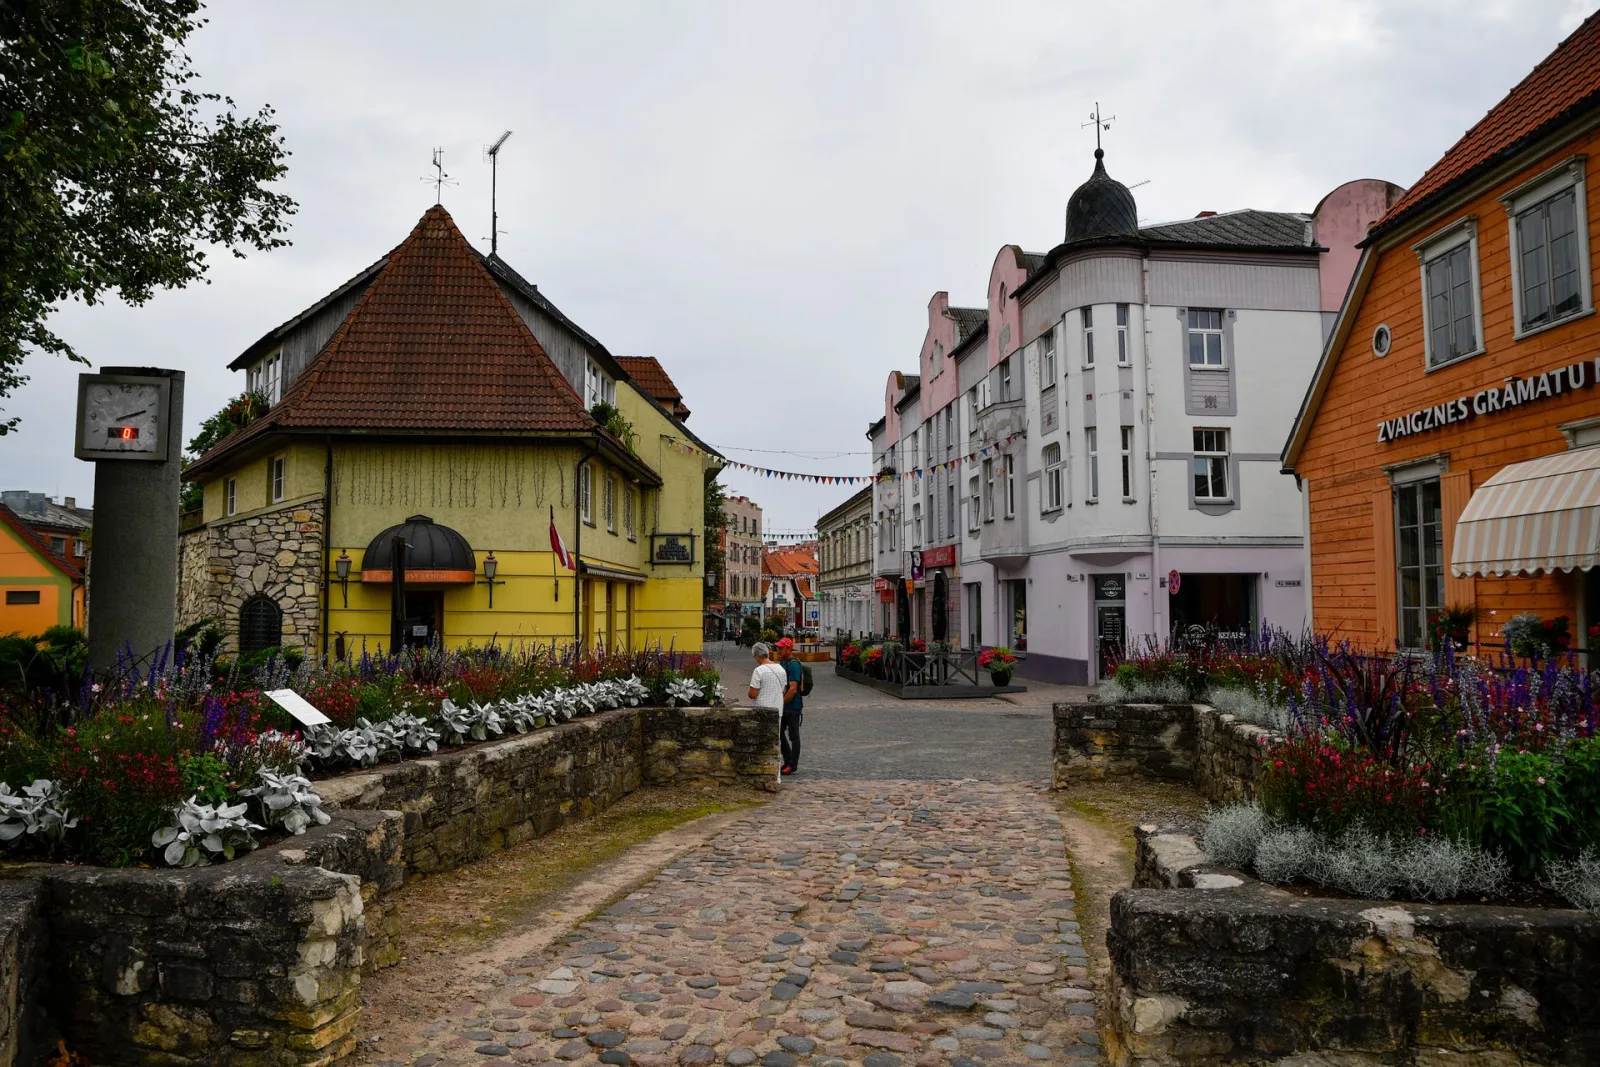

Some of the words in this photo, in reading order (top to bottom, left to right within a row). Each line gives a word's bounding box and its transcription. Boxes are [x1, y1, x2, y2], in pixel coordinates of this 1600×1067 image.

[120, 385, 132, 394] 12
[1377, 396, 1469, 443] ZVAIGZNES
[1473, 361, 1586, 415] GRĀMATU
[90, 413, 97, 421] 9
[151, 415, 157, 423] 3
[123, 428, 131, 439] 0
